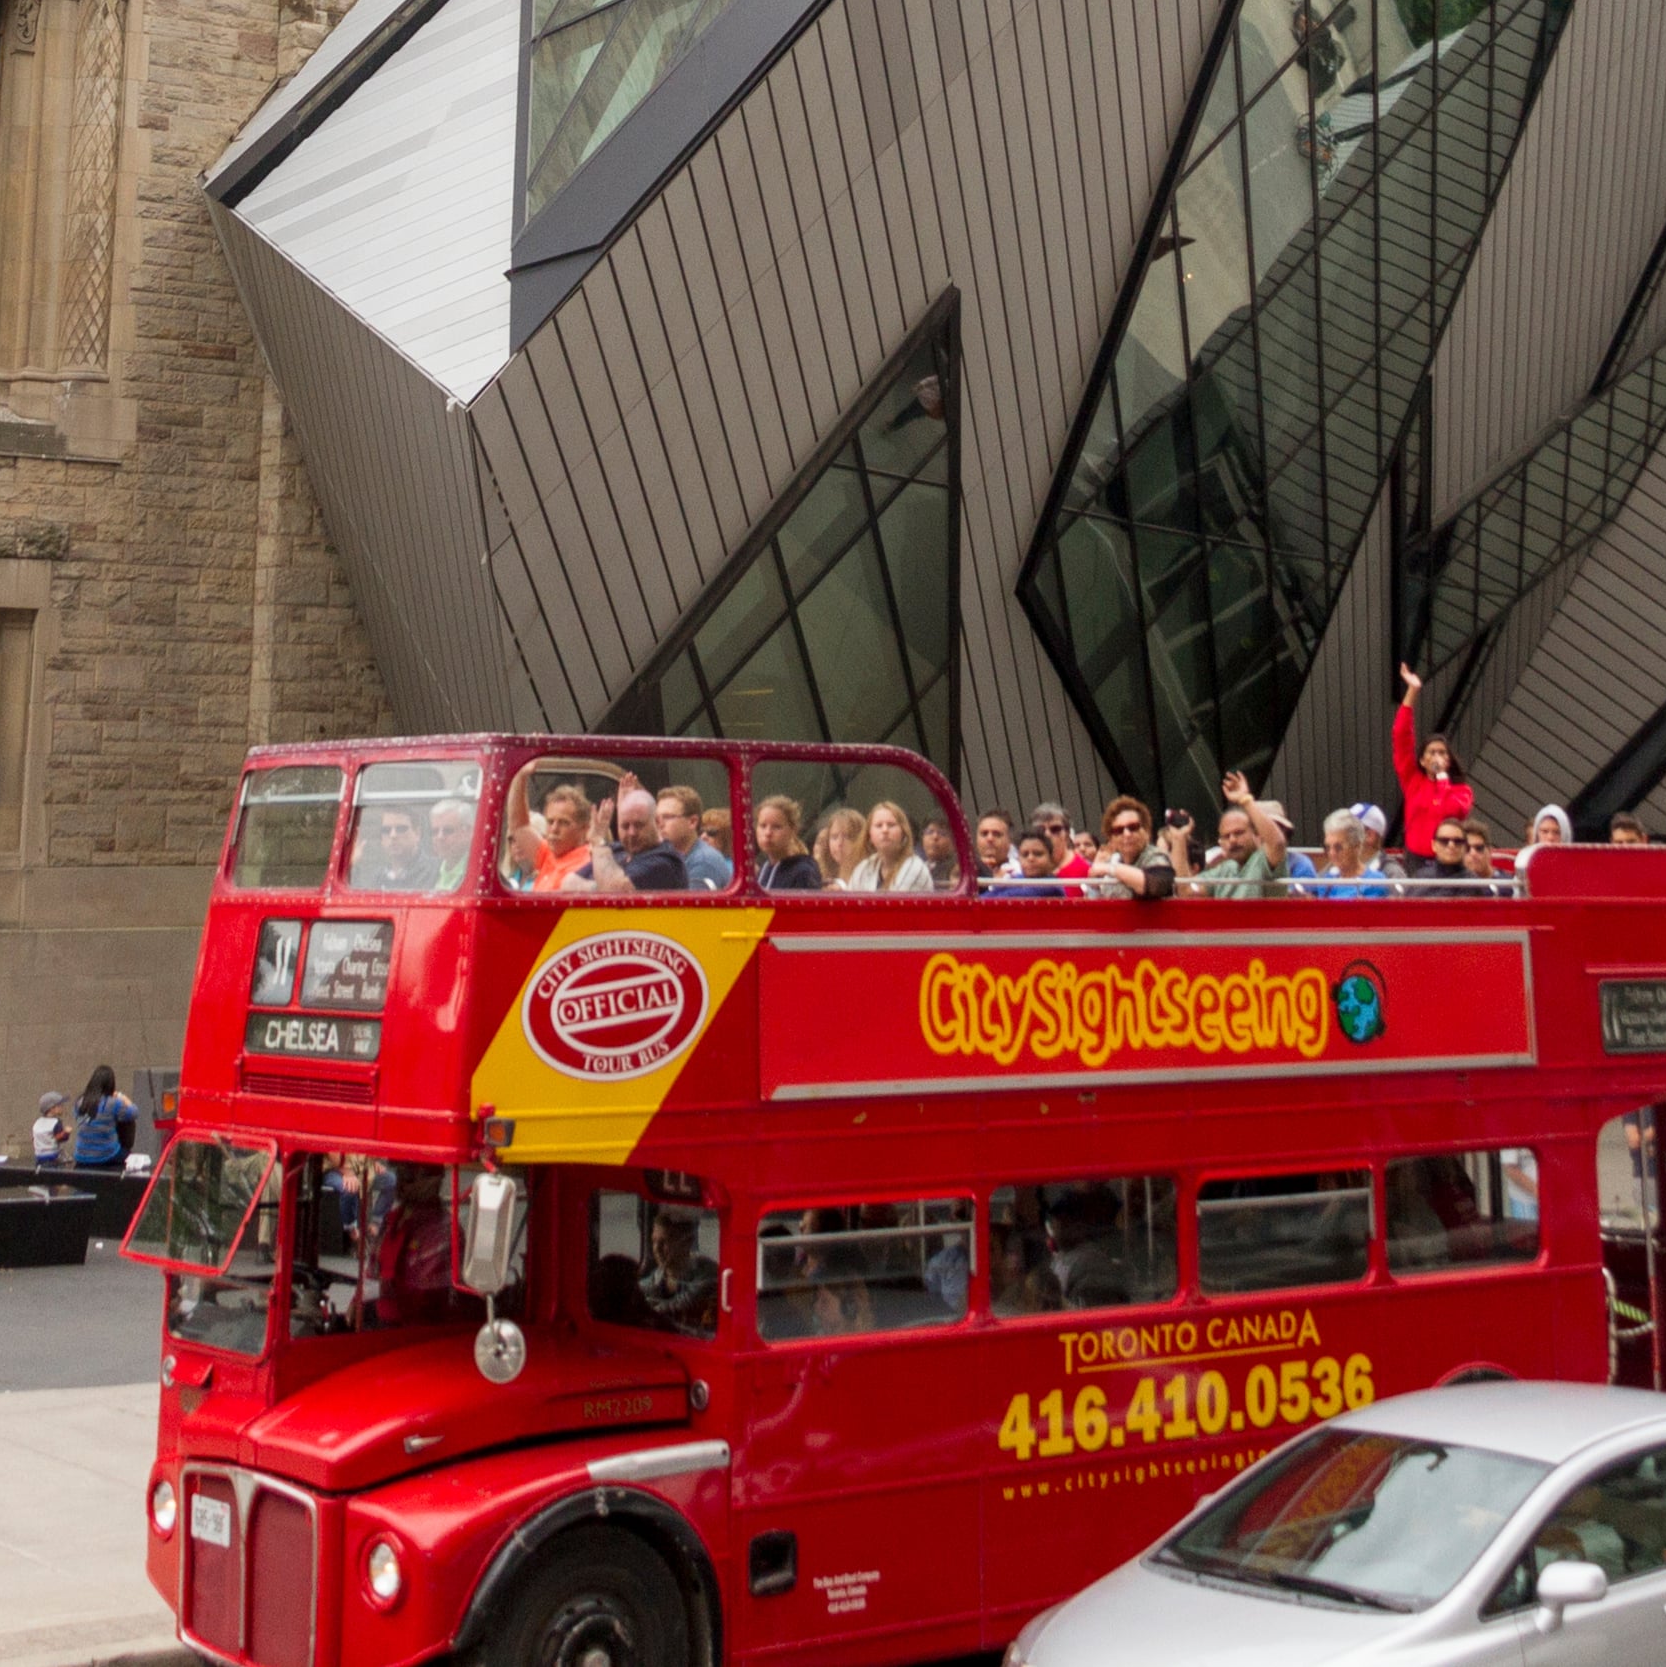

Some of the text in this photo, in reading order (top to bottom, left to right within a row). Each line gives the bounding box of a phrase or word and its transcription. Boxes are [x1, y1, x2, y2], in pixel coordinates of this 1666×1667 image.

[537, 939, 687, 999] CITY SIGHTSEEING
[558, 982, 678, 1025] OFFICIAL
[265, 1019, 339, 1052] CHELSEA
[583, 1039, 670, 1073] TOUR BUS
[1059, 1308, 1321, 1374] TORONTO CANADA
[998, 1353, 1375, 1460] 416.410.0536
[1002, 1448, 1269, 1501] www.citysightseeingto
